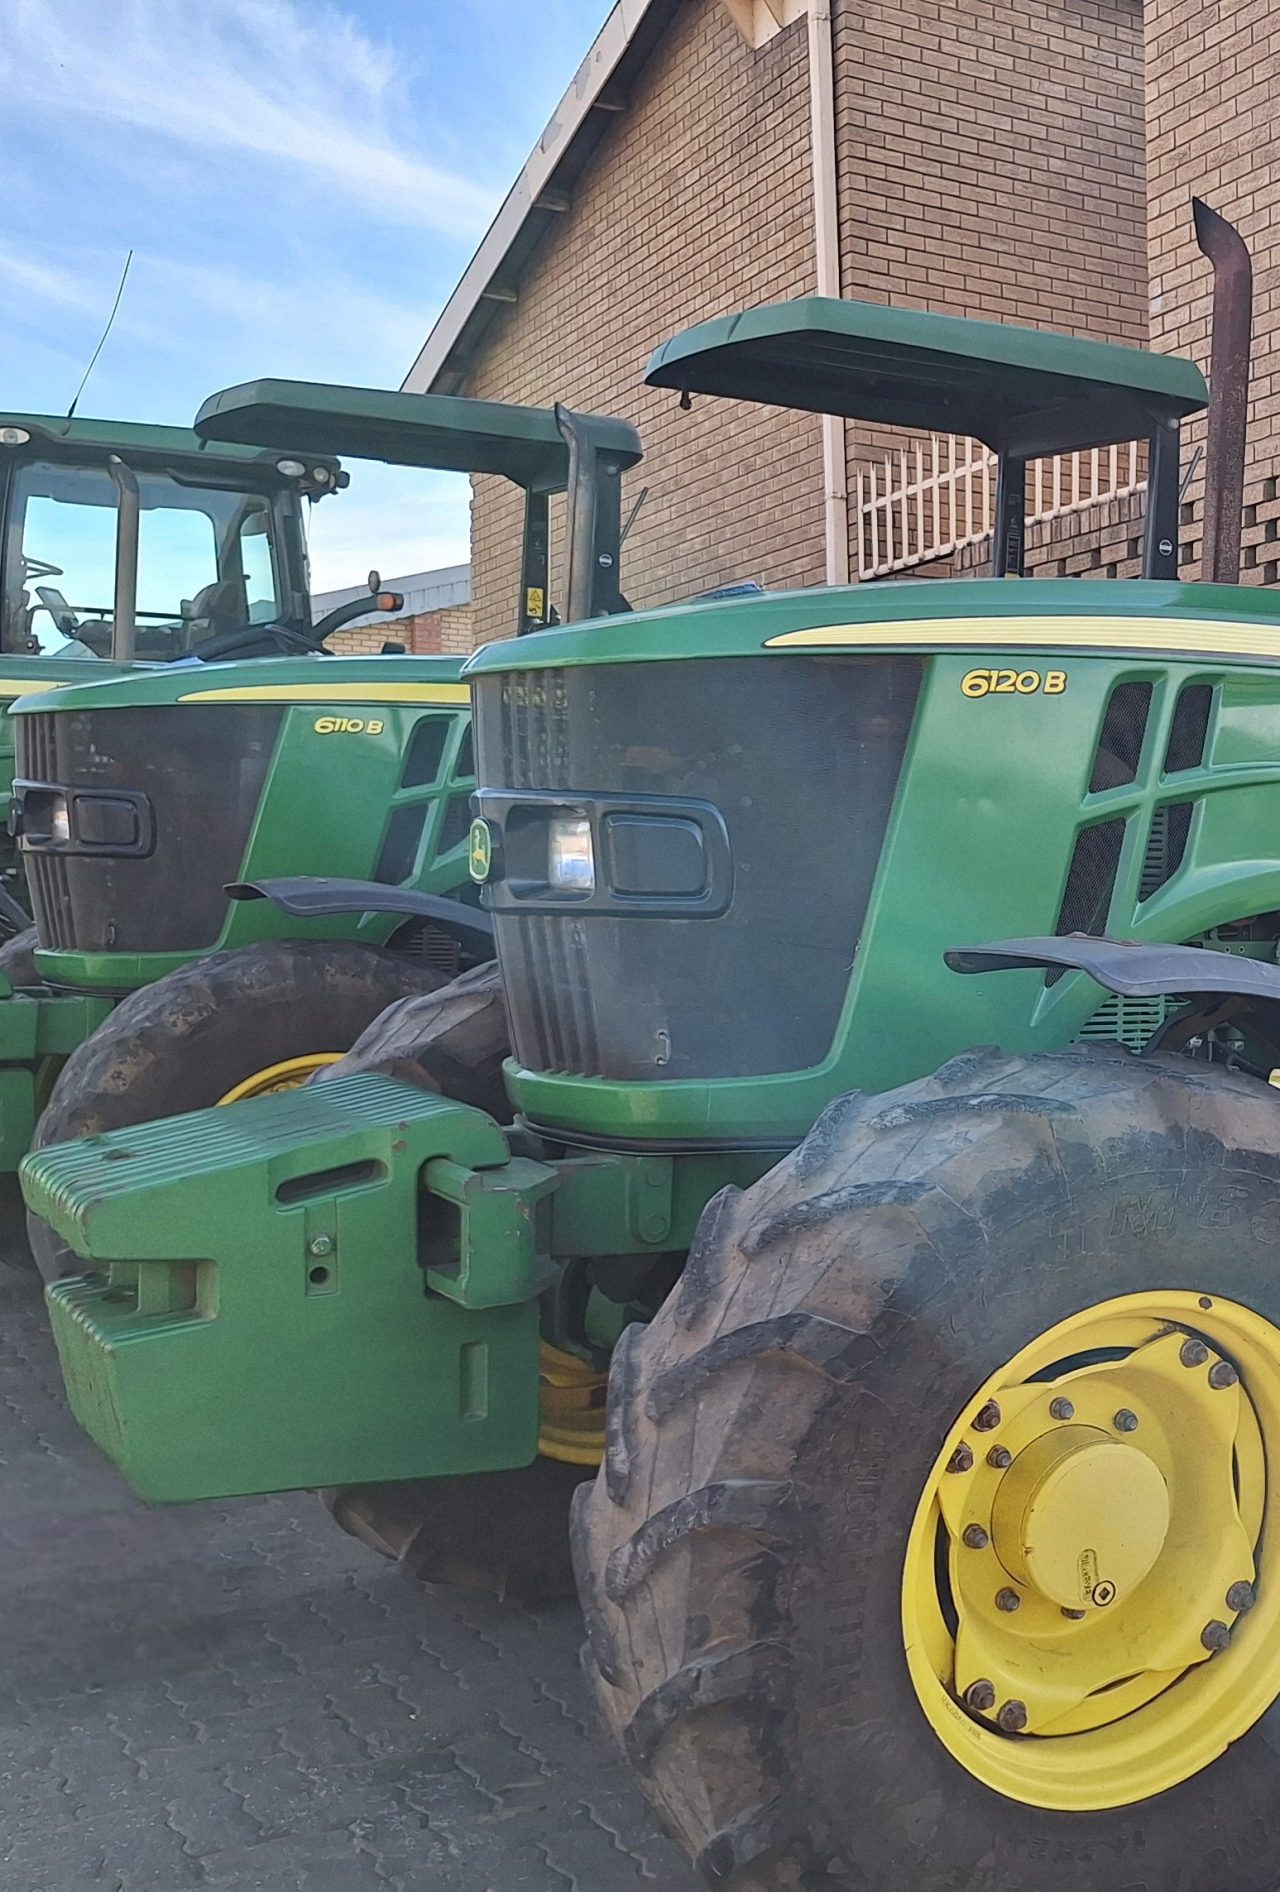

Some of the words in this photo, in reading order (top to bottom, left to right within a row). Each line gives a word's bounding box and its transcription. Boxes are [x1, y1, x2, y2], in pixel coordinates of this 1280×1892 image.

[961, 668, 1041, 698] 6120
[1042, 670, 1068, 694] B
[314, 716, 364, 734] 6110
[365, 720, 384, 735] B
